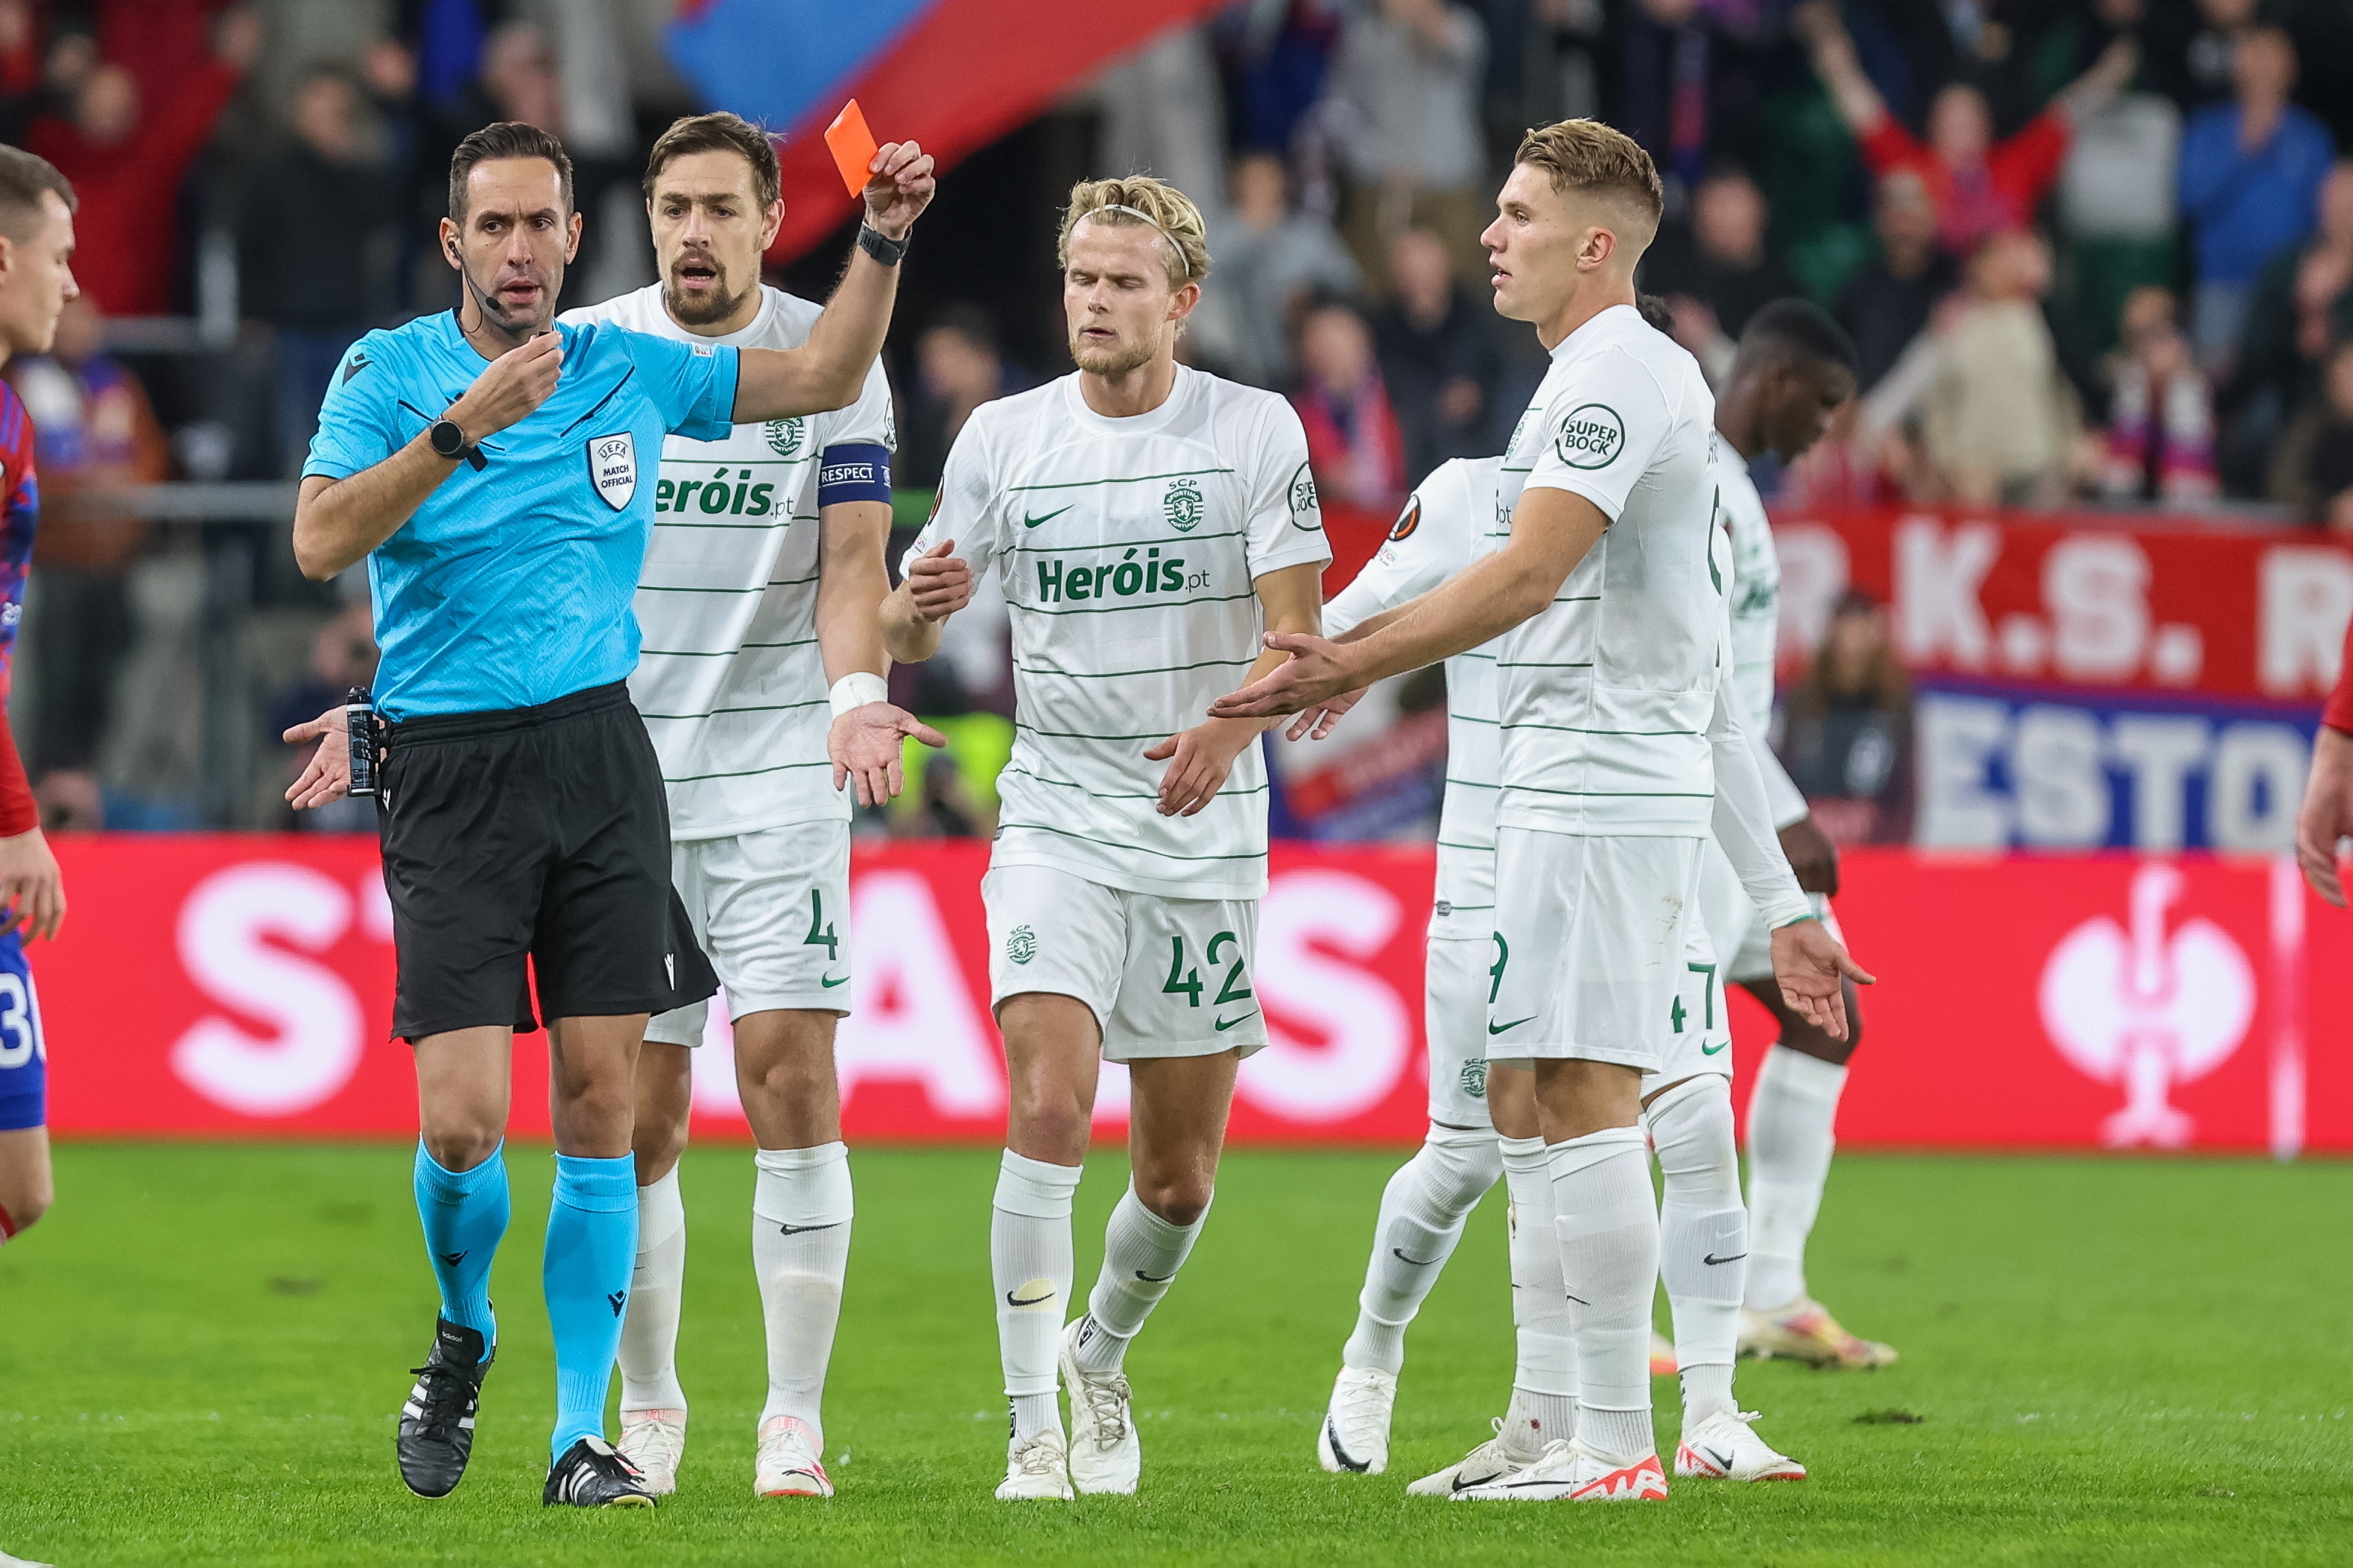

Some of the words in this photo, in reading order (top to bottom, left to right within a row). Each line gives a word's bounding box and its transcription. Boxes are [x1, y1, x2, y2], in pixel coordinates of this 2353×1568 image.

[1565, 420, 1618, 444] SUPER
[600, 442, 627, 459] UEFA
[1565, 434, 1610, 456] BOCK
[603, 464, 630, 477] MATCH
[821, 466, 873, 483] RESPECT
[601, 474, 633, 489] OFFICIAL
[1168, 478, 1197, 490] SCP
[656, 466, 794, 518] eróis.pt
[1166, 490, 1200, 504] SPORTING
[1170, 518, 1200, 528] PORTUGAL
[1036, 547, 1211, 603] Heróis.pt
[803, 888, 839, 961] 4
[1010, 924, 1030, 936] SCP
[1162, 930, 1252, 1008] 42
